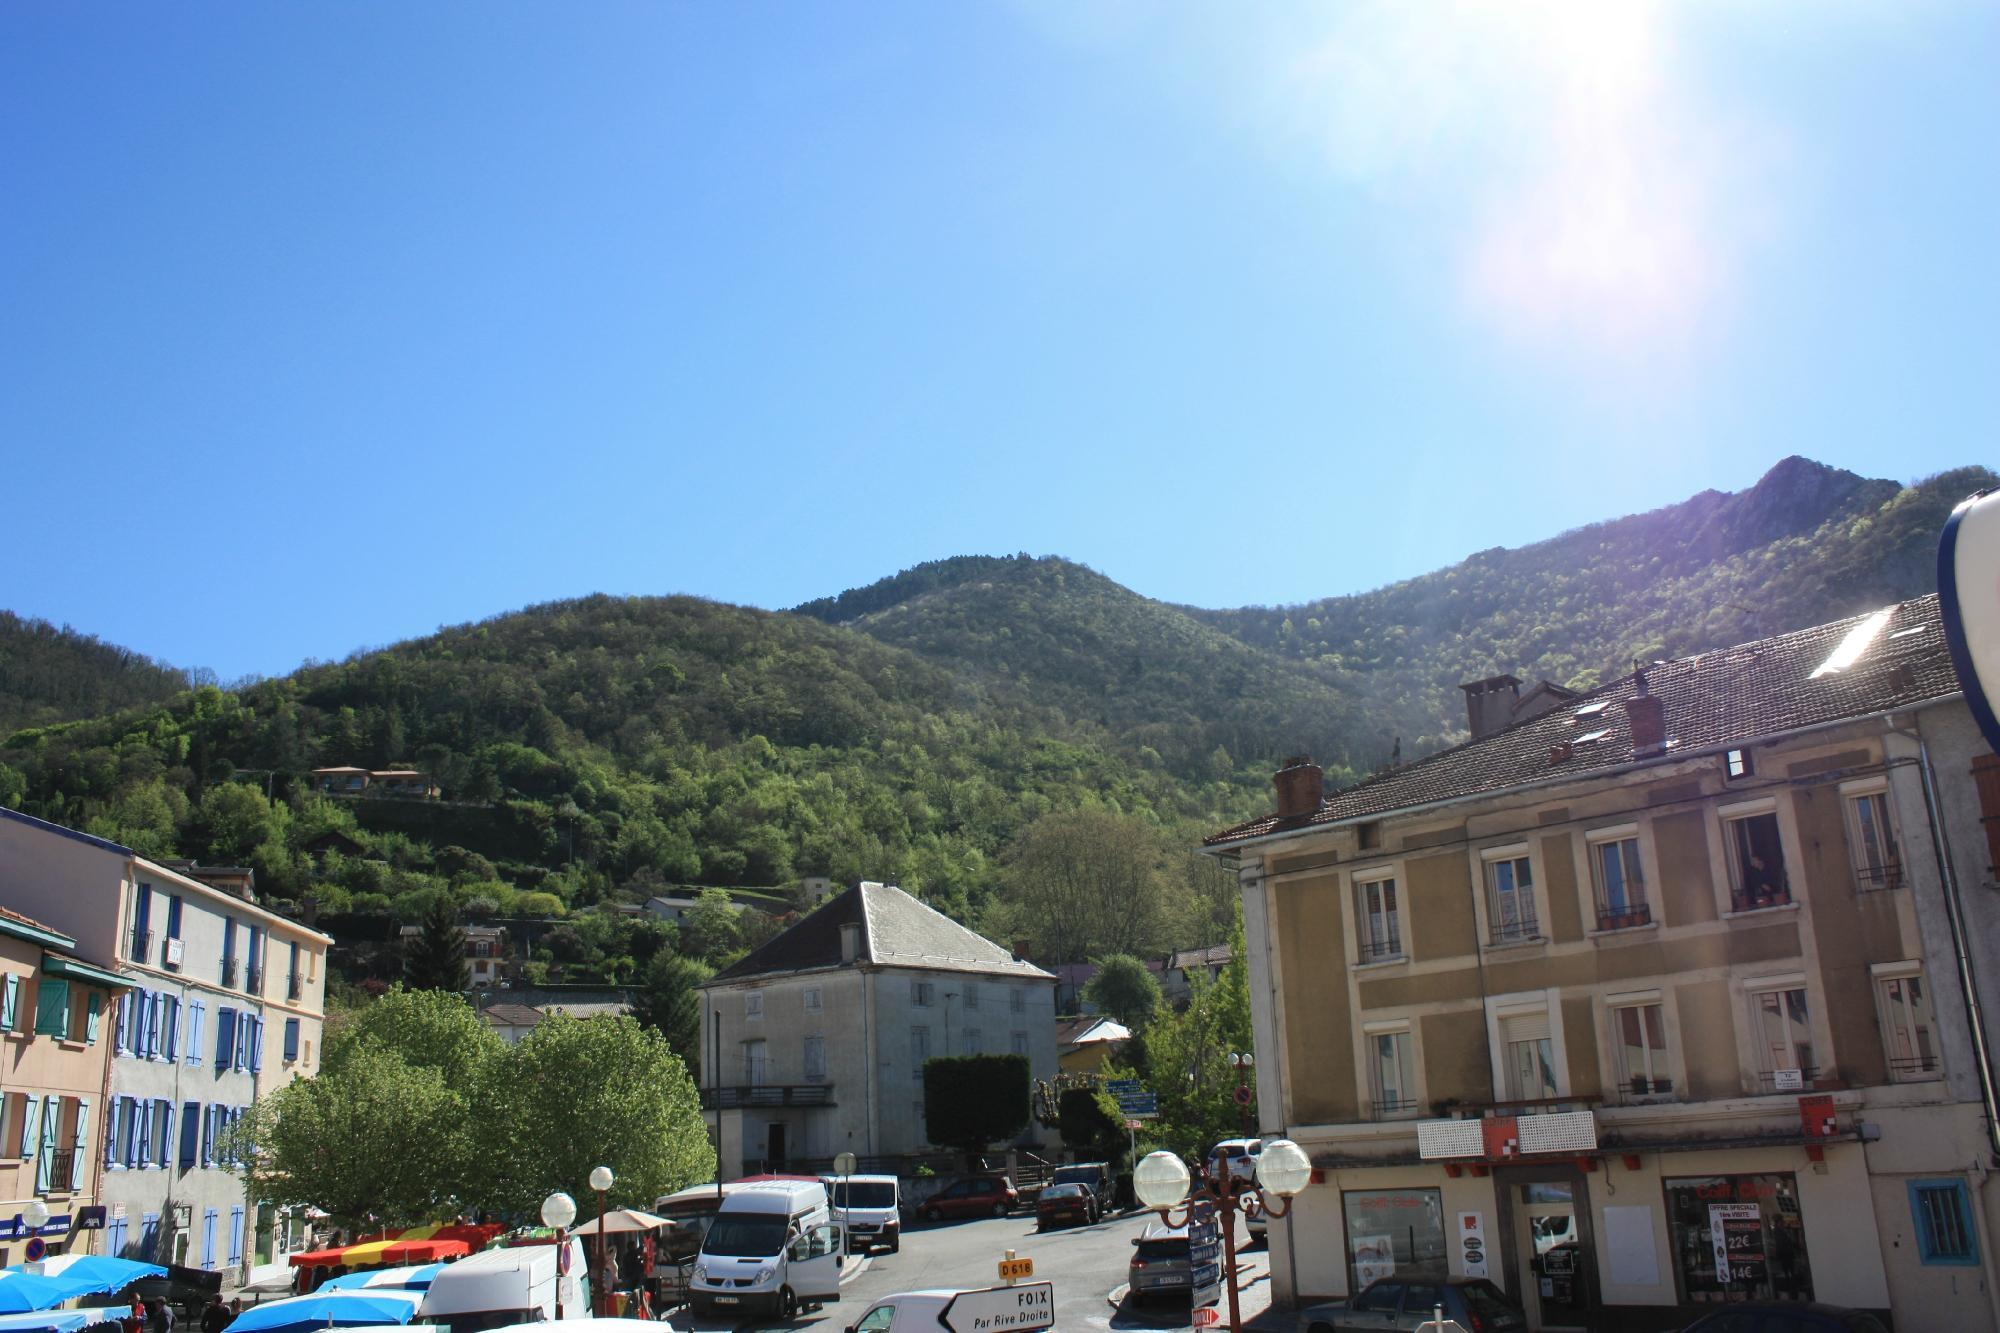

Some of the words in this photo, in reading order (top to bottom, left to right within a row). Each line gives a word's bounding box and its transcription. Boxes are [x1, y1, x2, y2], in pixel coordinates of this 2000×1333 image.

[83, 1217, 100, 1227] AXA
[1728, 1234, 1751, 1249] 22€
[1002, 1265, 1009, 1276] D
[1011, 1263, 1031, 1274] 618
[1730, 1266, 1753, 1280] 14€
[1018, 1290, 1047, 1306] FOIX
[974, 1317, 990, 1329] Par
[994, 1313, 1015, 1326] Rive
[1019, 1308, 1048, 1323] Droite
